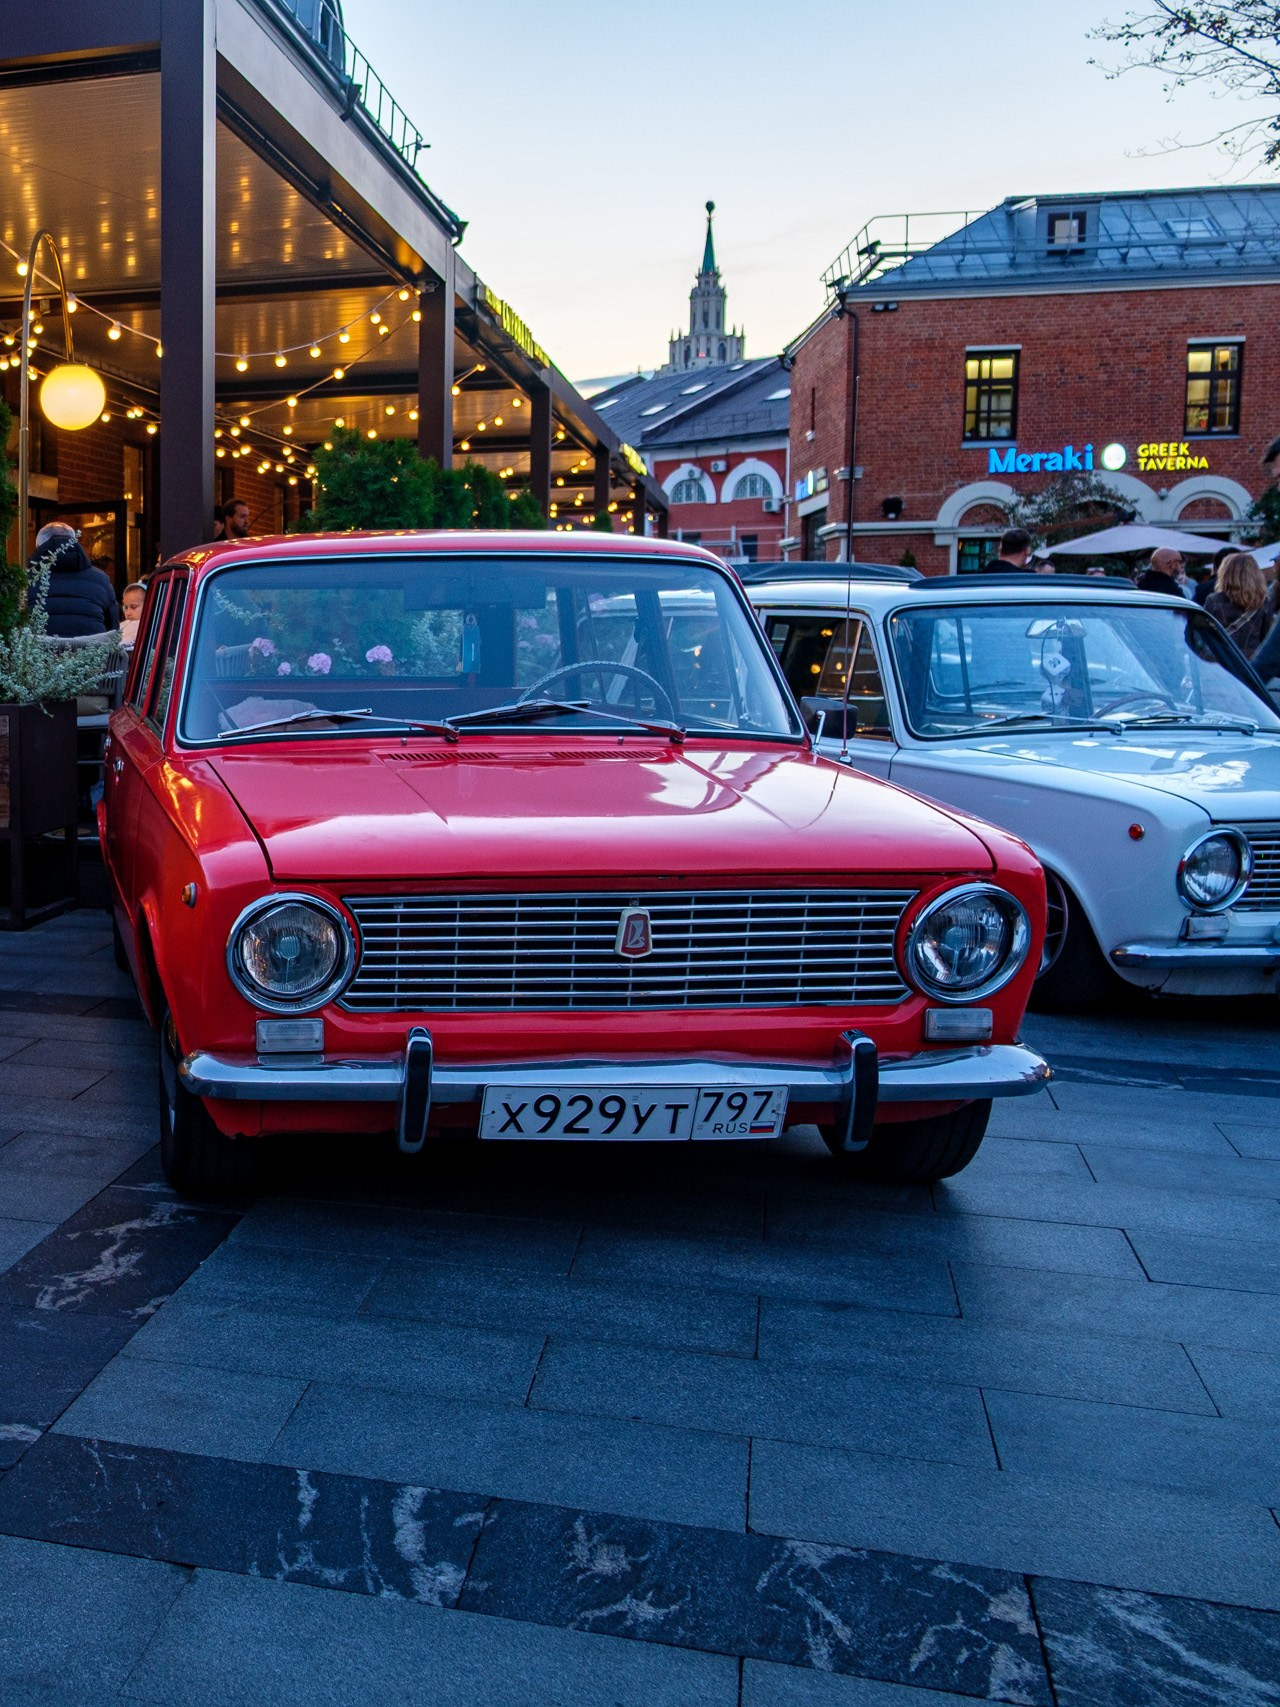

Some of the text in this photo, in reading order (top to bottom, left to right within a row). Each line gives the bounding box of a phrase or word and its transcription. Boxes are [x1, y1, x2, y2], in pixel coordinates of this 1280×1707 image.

[1137, 443, 1190, 457] GREEK
[988, 444, 1093, 474] Meraki
[1137, 456, 1209, 471] TAVERNA
[702, 1090, 774, 1123] 797
[712, 1122, 748, 1134] RUS
